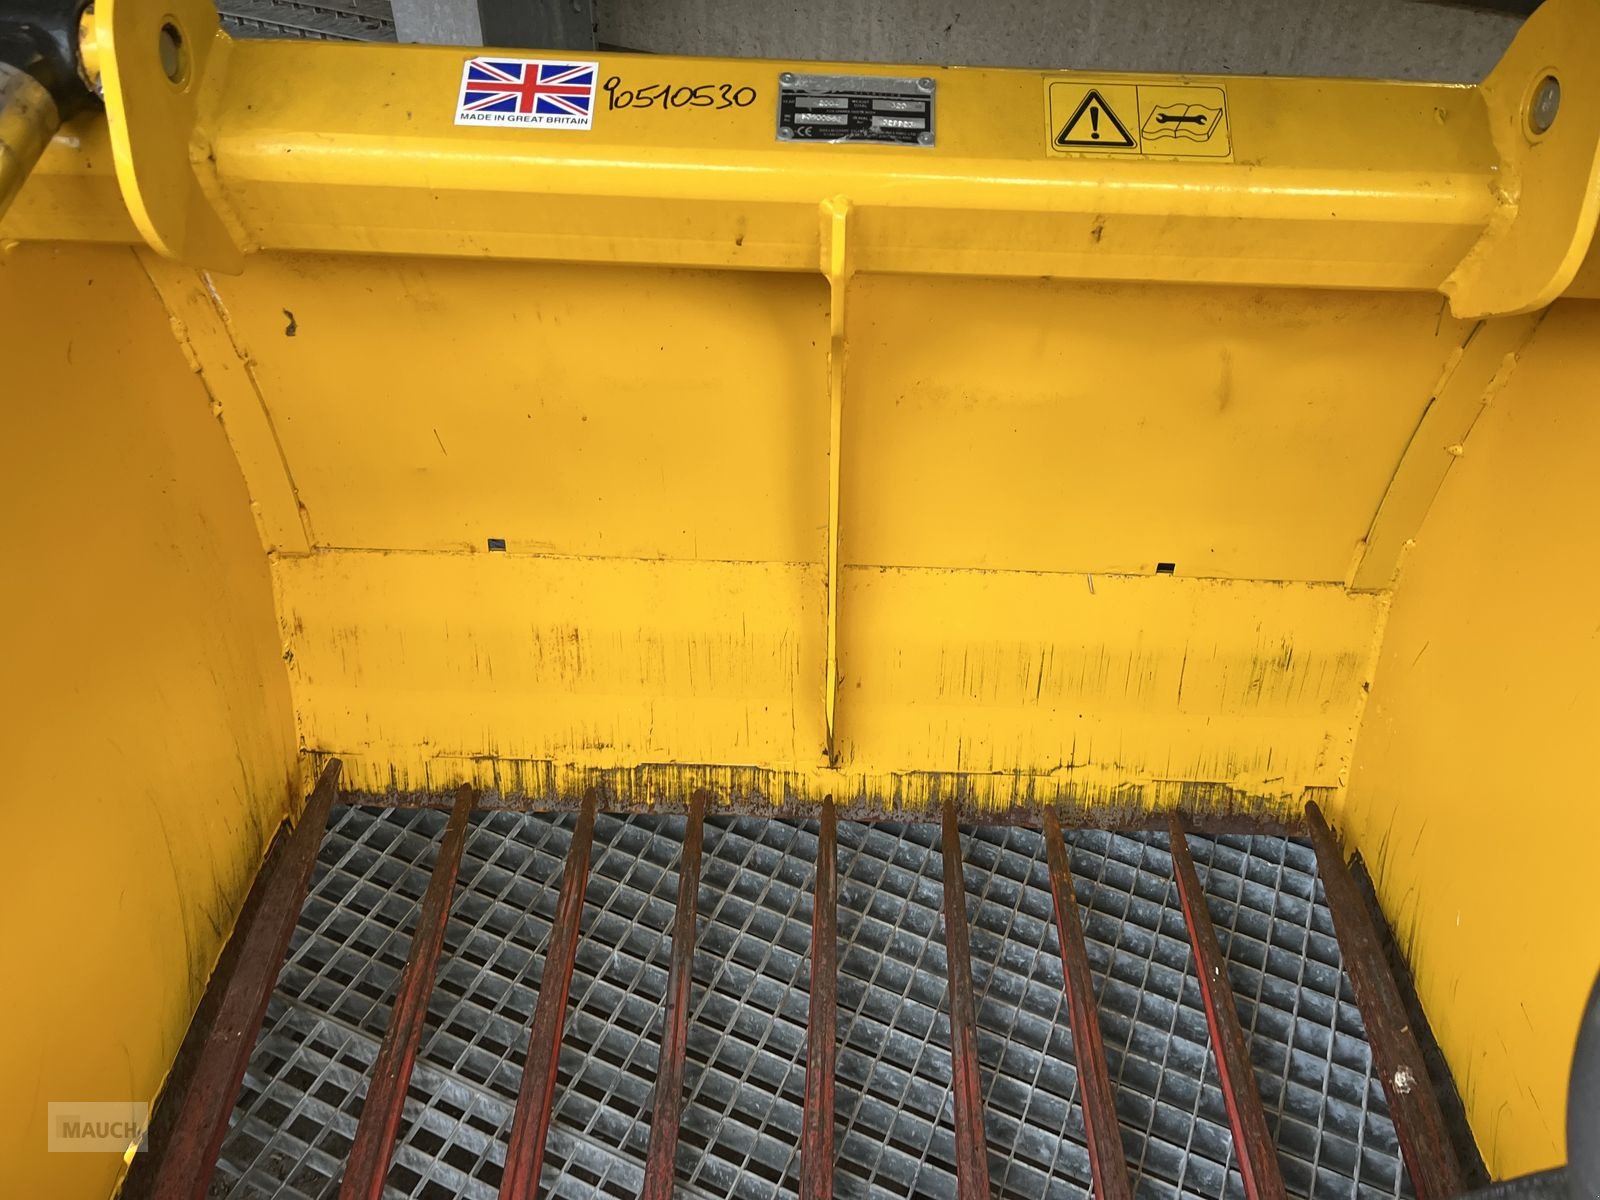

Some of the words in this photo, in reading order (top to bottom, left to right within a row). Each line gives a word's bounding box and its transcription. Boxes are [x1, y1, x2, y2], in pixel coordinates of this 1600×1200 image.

[602, 76, 757, 111] 90510530
[460, 113, 491, 121] MADE
[507, 115, 544, 123] GREAT
[546, 116, 588, 125] BRITAIN
